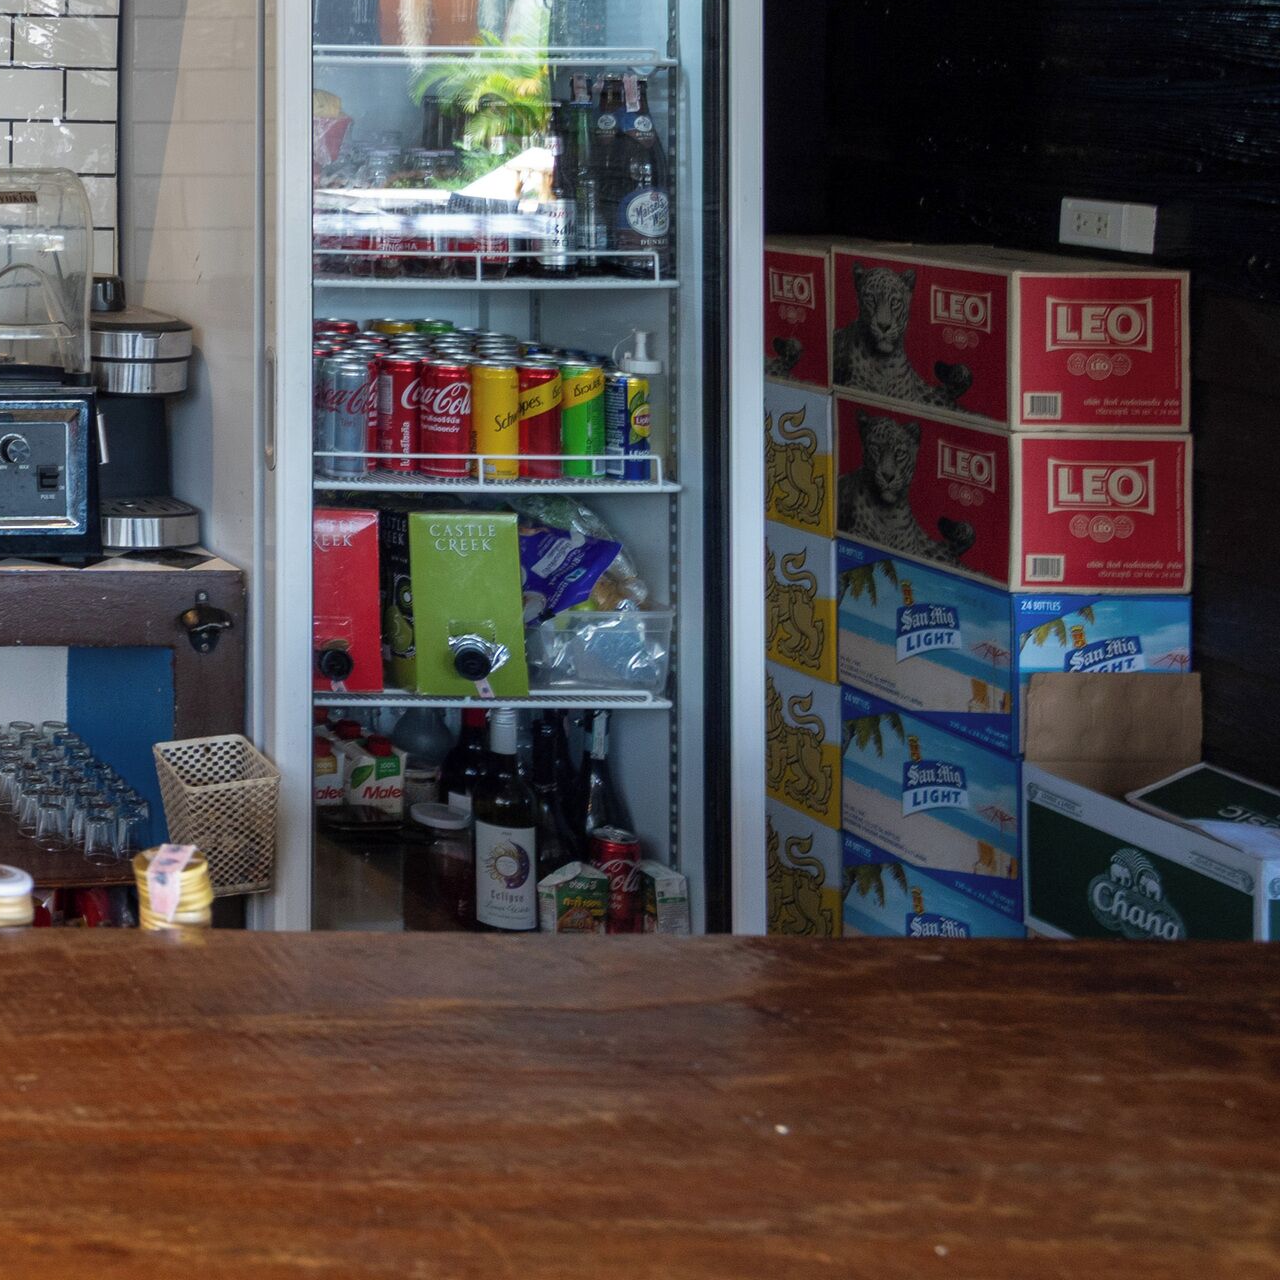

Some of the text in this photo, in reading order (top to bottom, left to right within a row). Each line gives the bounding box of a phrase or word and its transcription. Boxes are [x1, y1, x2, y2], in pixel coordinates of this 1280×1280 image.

[774, 274, 812, 302] LEO
[937, 293, 989, 326] LEO
[1056, 304, 1145, 344] LEO
[1090, 361, 1108, 371] LEO
[942, 450, 992, 483] LEO
[1057, 467, 1148, 505] LEO
[429, 524, 497, 538] CASTLE
[1092, 524, 1111, 534] LEO
[435, 538, 492, 557] CREEK
[1020, 600, 1061, 612] 24 BOTTLES
[901, 605, 957, 631] San Mig
[905, 632, 954, 652] LIGHT
[1068, 638, 1138, 672] San Mig
[907, 761, 963, 788] San Mig
[313, 786, 346, 800] alee
[911, 790, 961, 808] LIGHT
[490, 889, 525, 903] Eclipse
[1092, 882, 1180, 940] Chang
[910, 917, 940, 937] San
